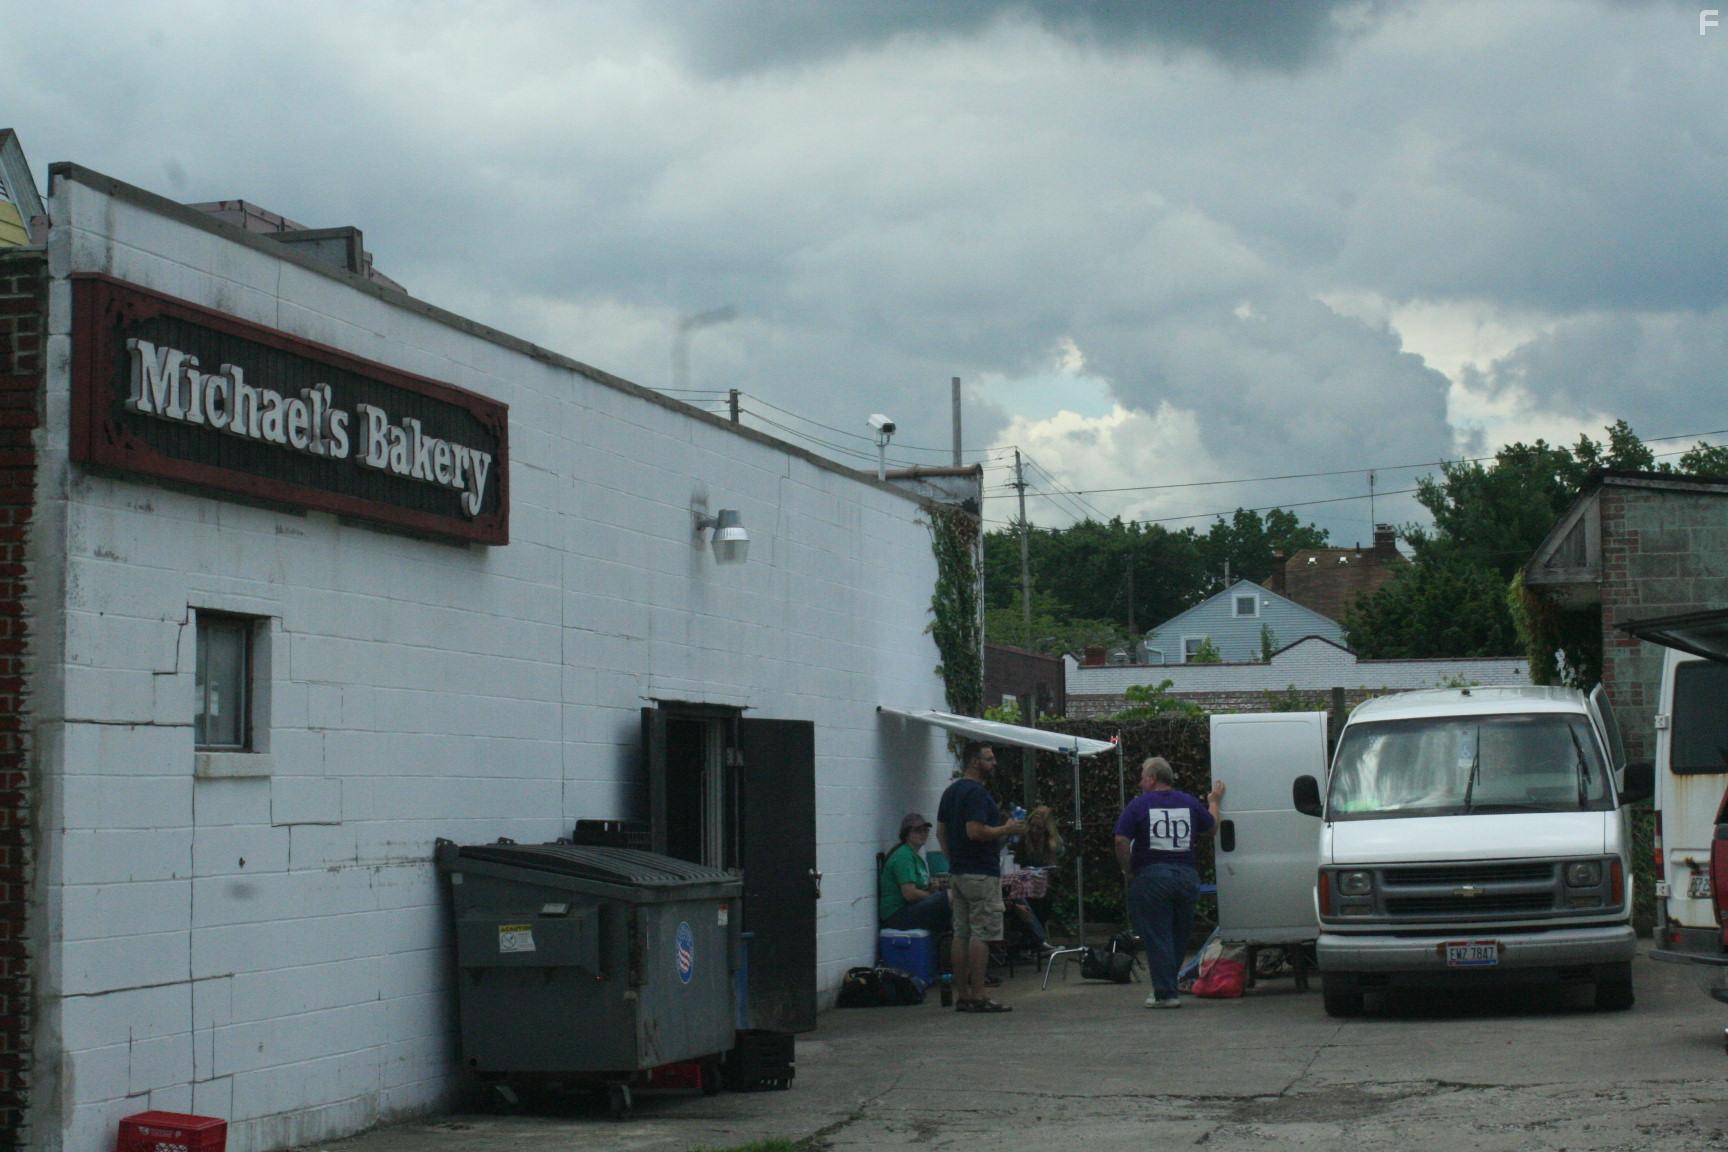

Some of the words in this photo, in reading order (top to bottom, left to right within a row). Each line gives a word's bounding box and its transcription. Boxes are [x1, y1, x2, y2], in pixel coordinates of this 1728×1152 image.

[127, 338, 349, 459] Michael's
[356, 403, 491, 517] Bakery
[1152, 810, 1189, 848] dp
